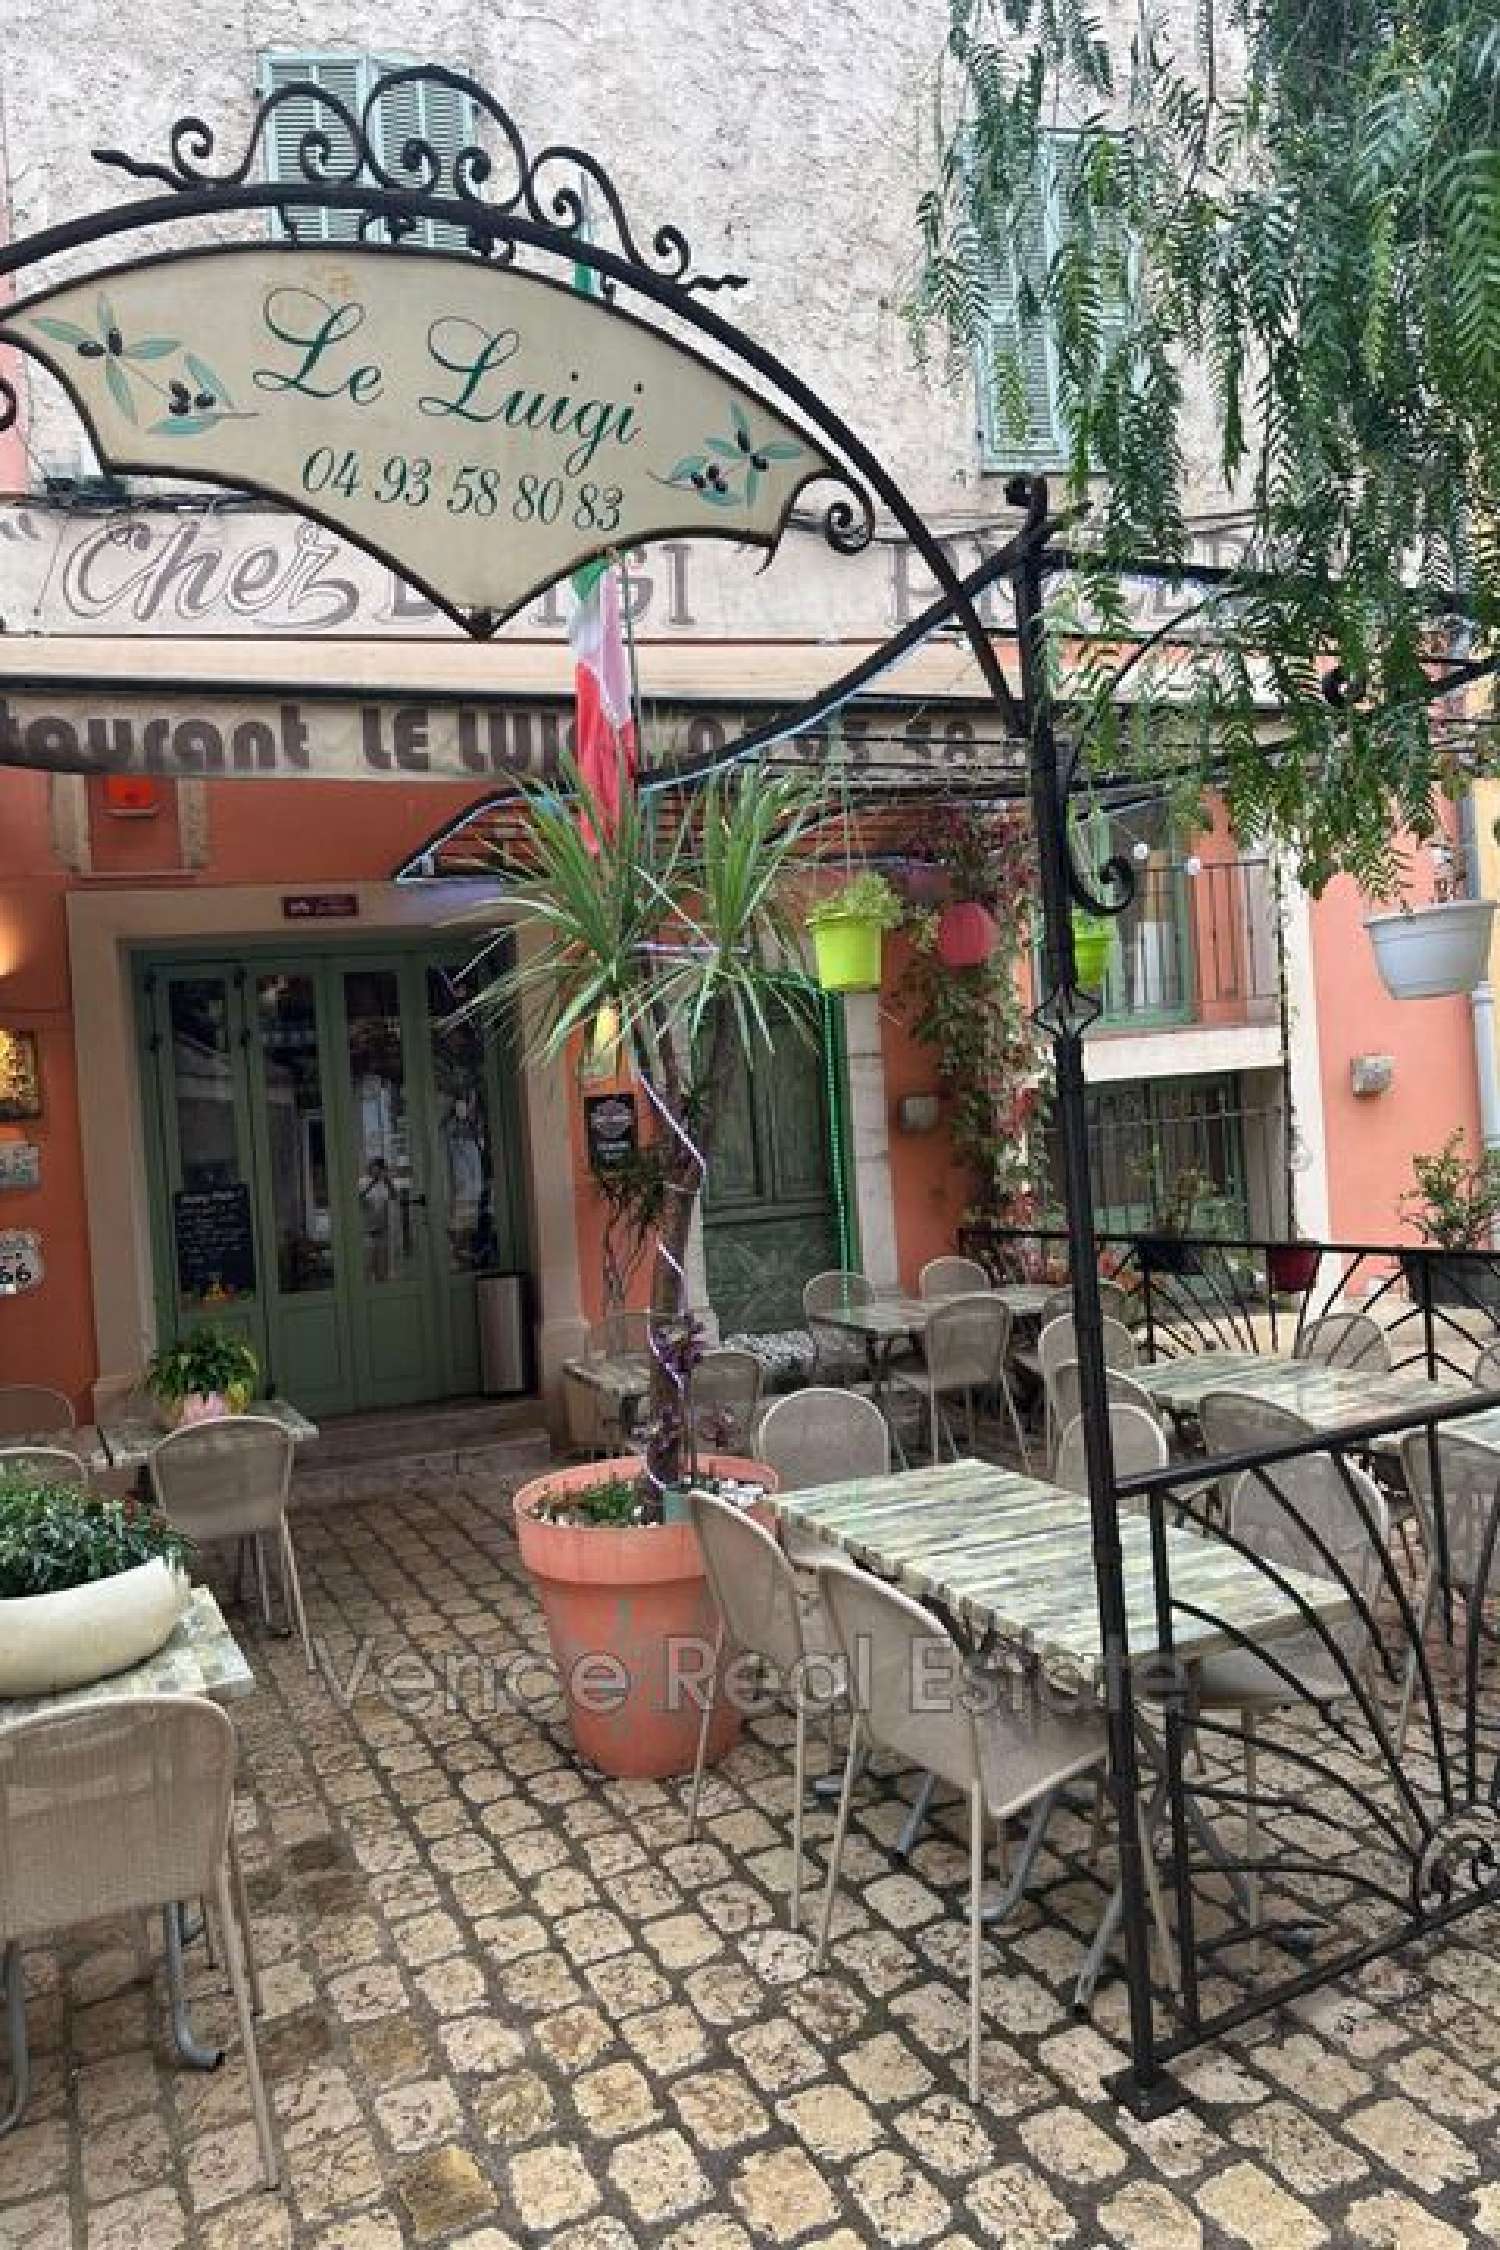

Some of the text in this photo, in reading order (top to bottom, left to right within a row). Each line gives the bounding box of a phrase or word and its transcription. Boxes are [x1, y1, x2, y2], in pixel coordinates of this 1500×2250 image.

[253, 288, 641, 478] Le Luigi
[303, 446, 625, 531] 04 93 58 80 83
[362, 706, 430, 770] LE
